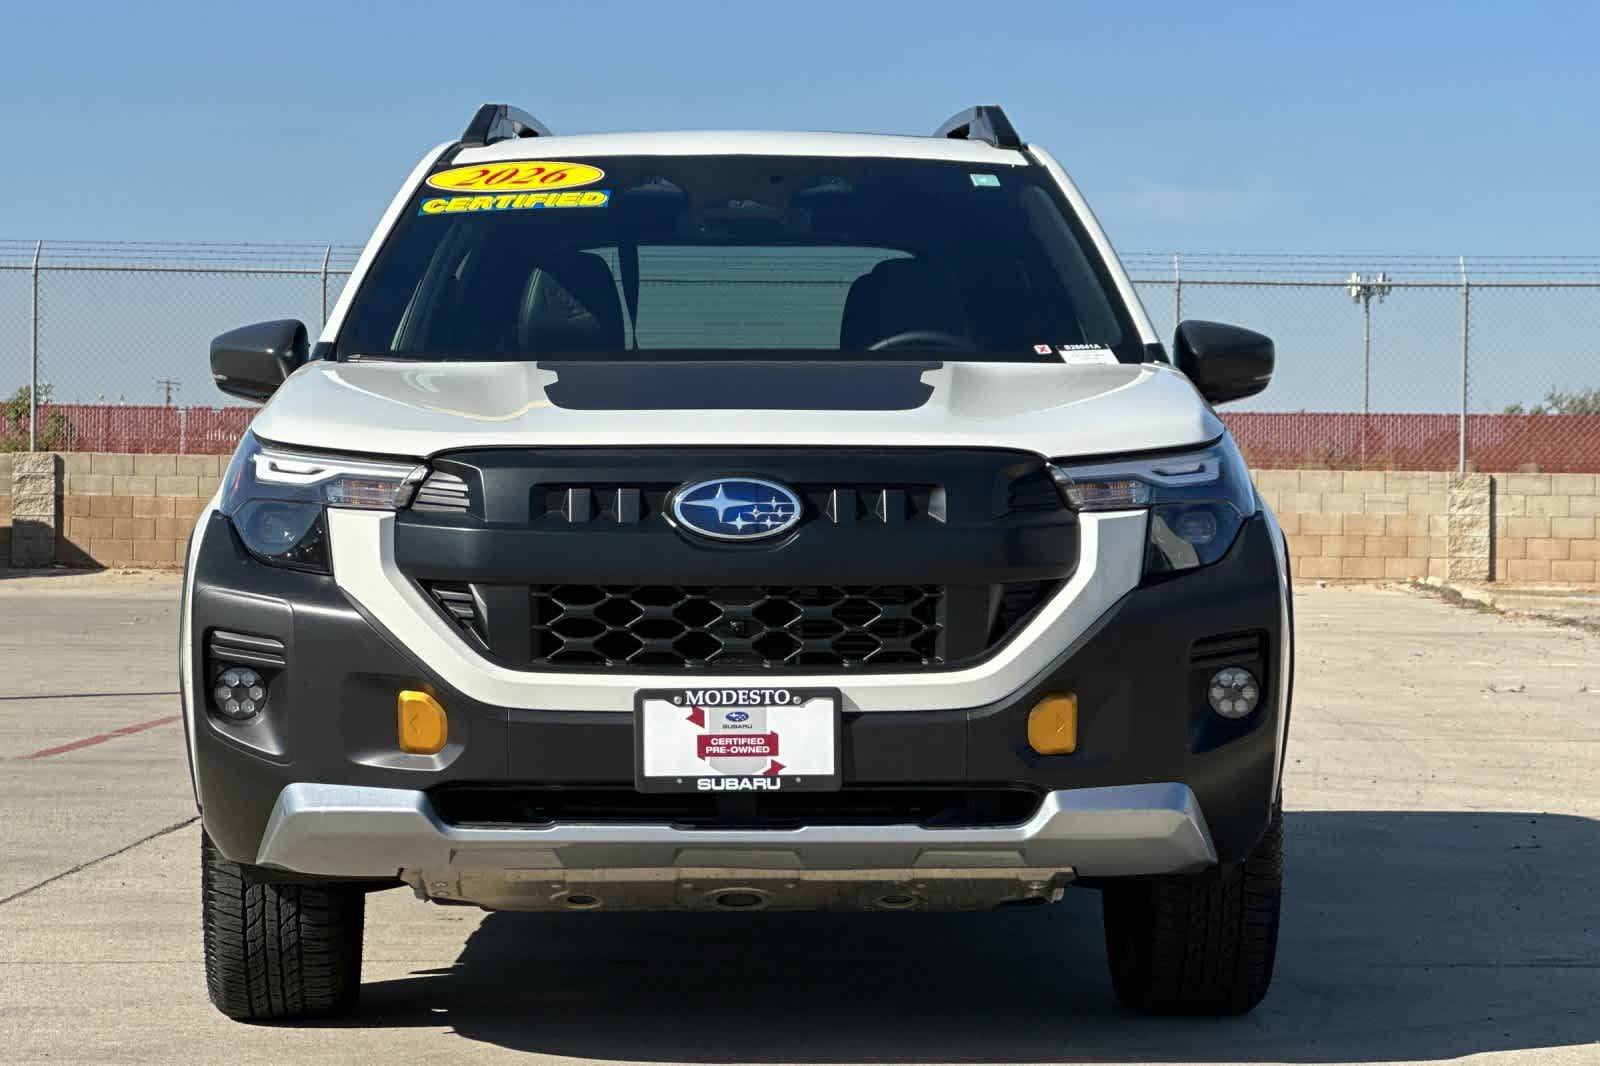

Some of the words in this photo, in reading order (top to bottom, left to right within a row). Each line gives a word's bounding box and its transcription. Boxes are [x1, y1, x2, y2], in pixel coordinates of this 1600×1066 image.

[451, 167, 576, 186] 2026
[422, 191, 609, 214] CERTIFIED
[684, 689, 791, 705] MODESTO
[710, 737, 765, 746] CERTIFIED
[705, 746, 770, 754] PRE-OWNED
[697, 777, 781, 790] SUBARU
